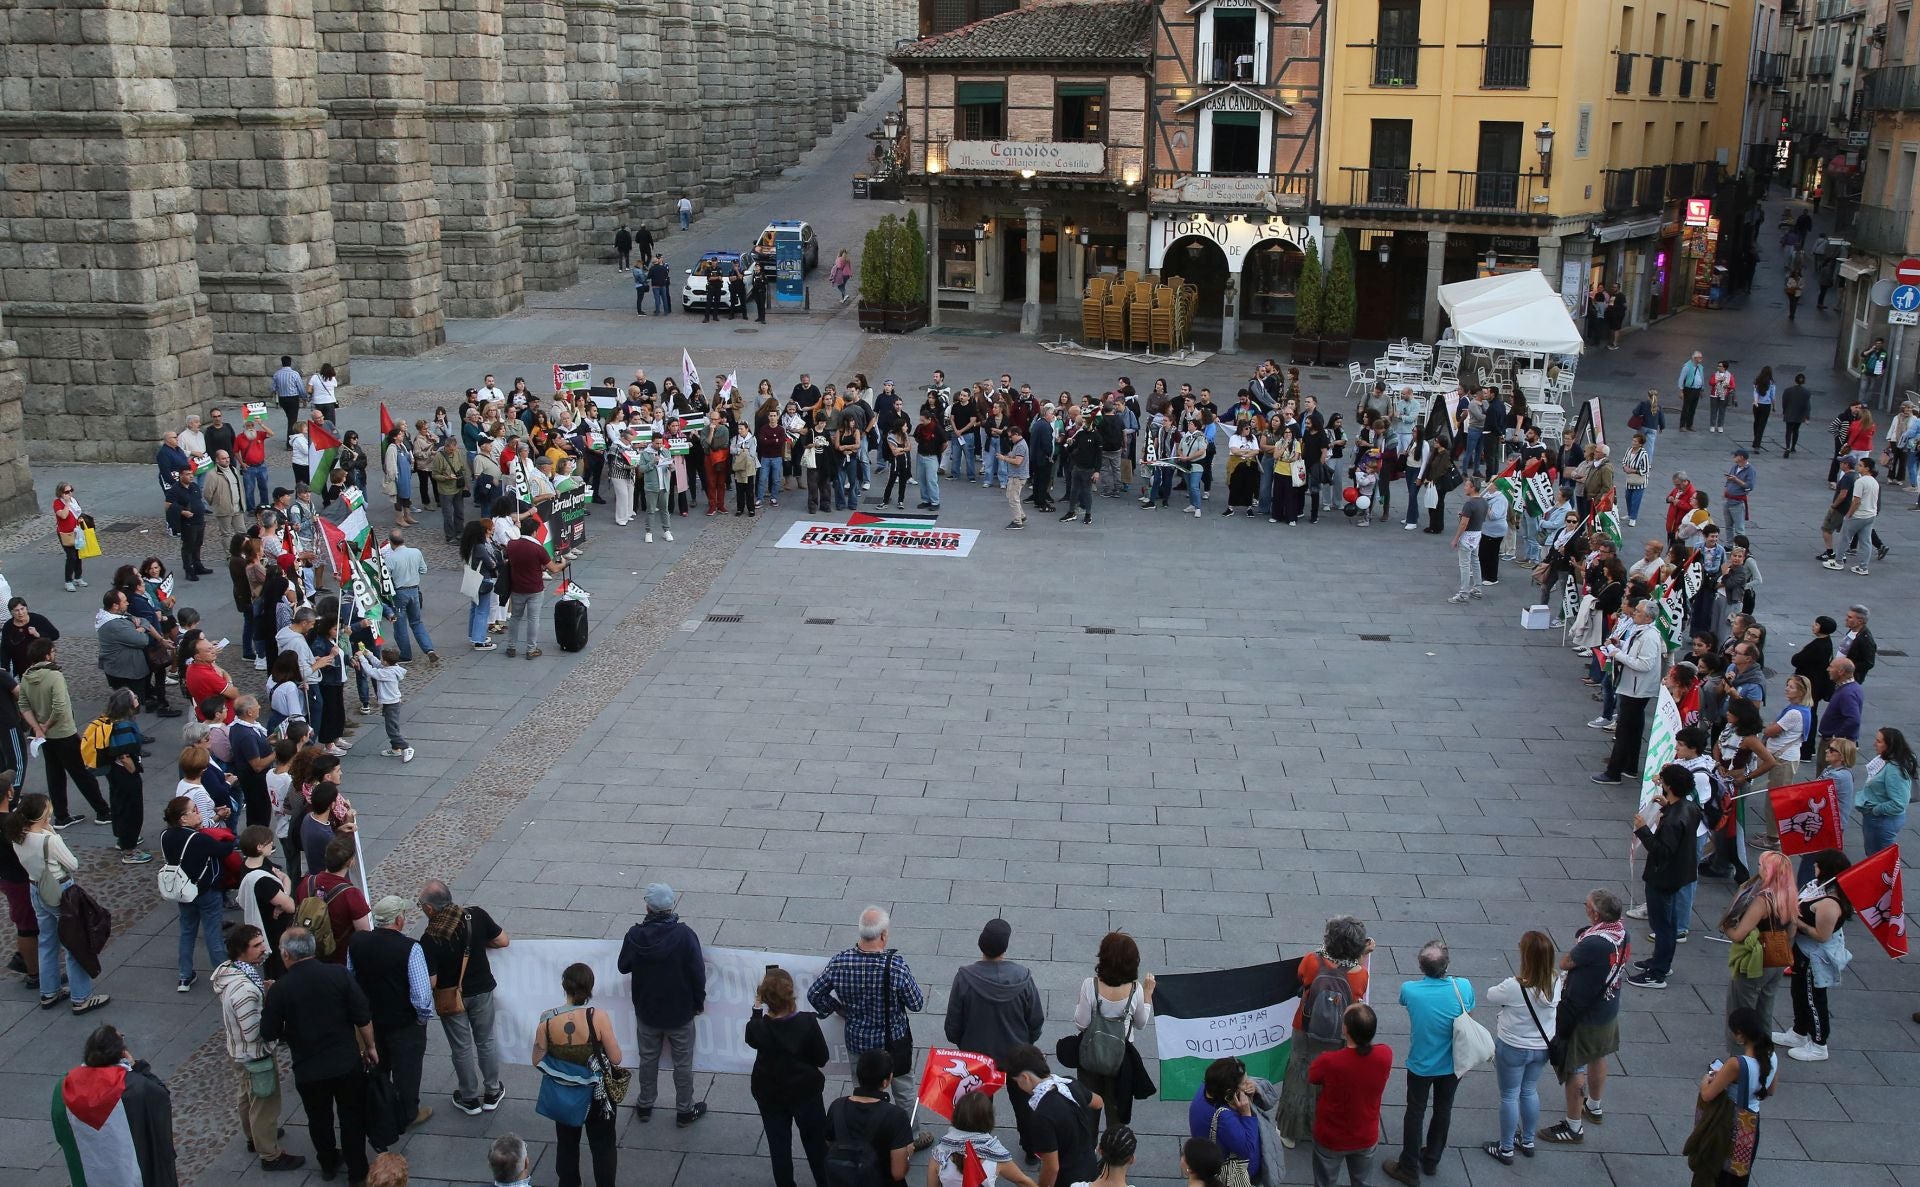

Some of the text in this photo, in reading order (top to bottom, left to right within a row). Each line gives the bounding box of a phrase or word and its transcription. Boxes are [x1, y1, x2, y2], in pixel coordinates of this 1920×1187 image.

[1206, 96, 1266, 111] CASA CANDIDO
[991, 142, 1059, 157] Candido
[960, 155, 1005, 166] Mesonero
[1006, 157, 1037, 168] Mayor
[1055, 158, 1089, 168] Castilla
[1164, 221, 1310, 256] HORNO DE ASAR
[1531, 478, 1549, 509] GENOCIDIO
[801, 532, 819, 541] EL
[820, 533, 885, 544] ESTADO
[885, 535, 960, 548] SIONISTA
[809, 526, 961, 539] DESTRUIR
[936, 1049, 976, 1060] Sindicato
